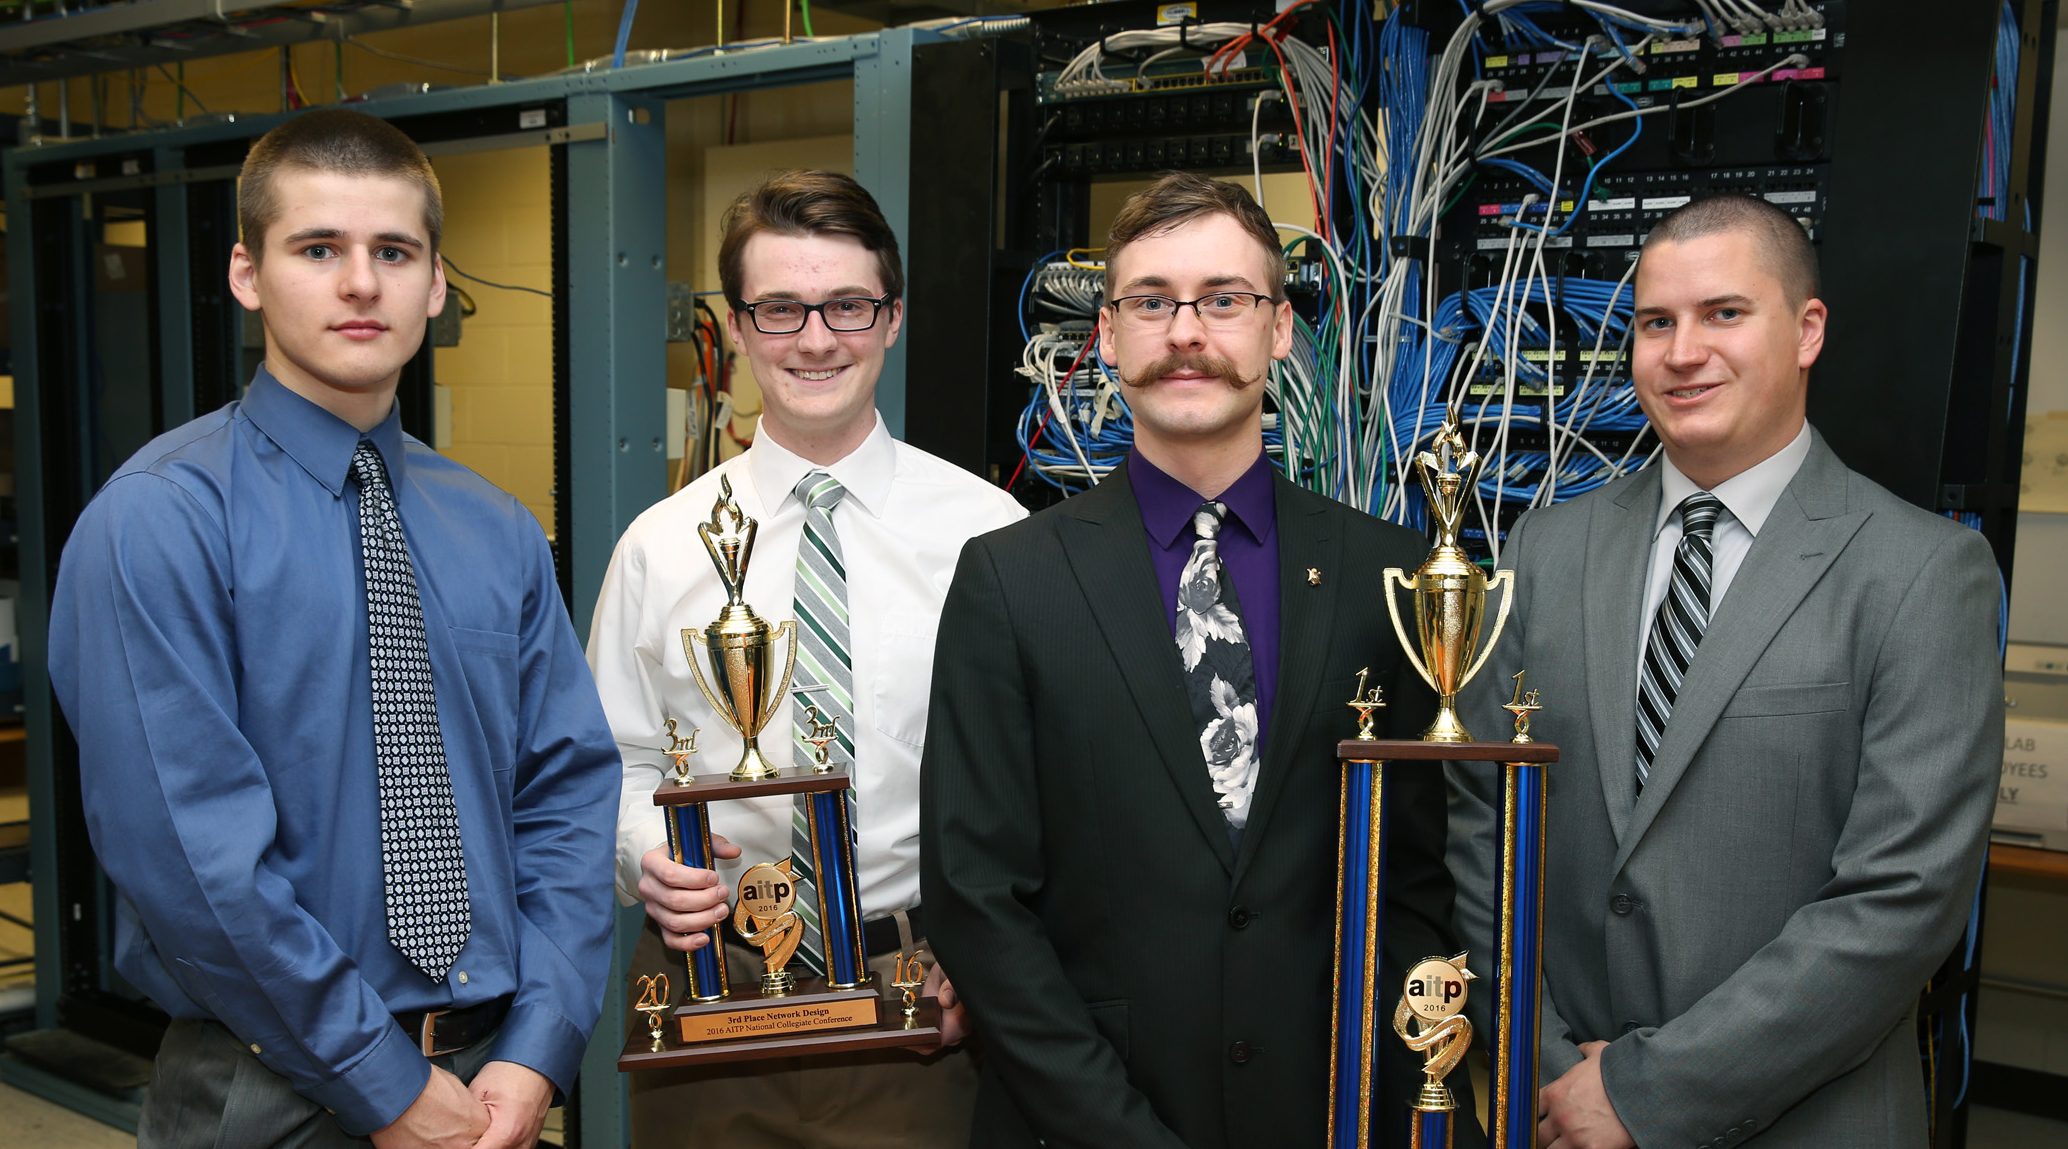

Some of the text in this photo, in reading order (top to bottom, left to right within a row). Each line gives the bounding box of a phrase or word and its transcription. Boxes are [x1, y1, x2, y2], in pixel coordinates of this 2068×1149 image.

[2005, 737, 2036, 751] LAB
[743, 880, 790, 902] aitp
[758, 904, 778, 912] 2016
[634, 972, 669, 1007] 20
[1408, 975, 1462, 1004] aitp
[727, 1008, 830, 1025] 3rd Place Network Design
[1423, 1004, 1446, 1012] 2016
[706, 1015, 853, 1036] 2016 AITP National Collegiate Conference
